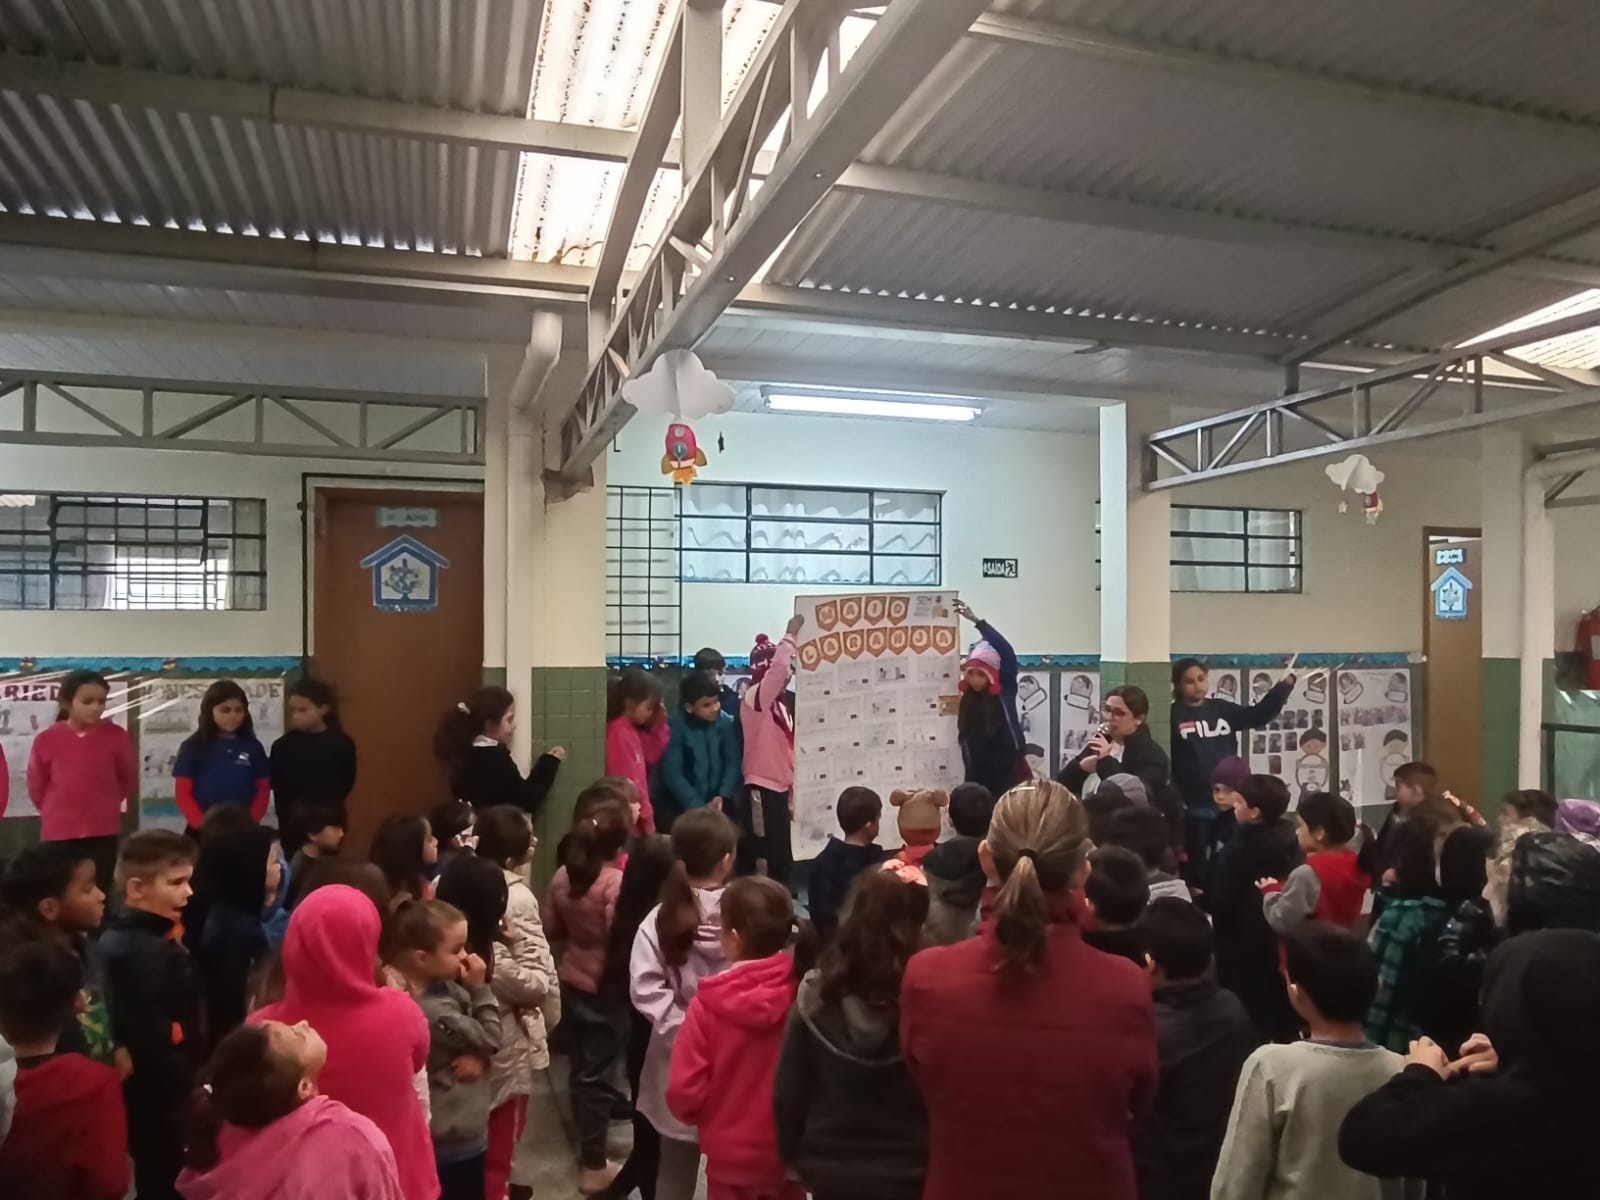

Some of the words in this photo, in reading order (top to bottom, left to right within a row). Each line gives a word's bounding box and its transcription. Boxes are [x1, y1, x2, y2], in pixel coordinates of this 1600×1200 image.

[818, 600, 905, 624] MAIO
[804, 628, 952, 664] LARANJA
[1179, 718, 1231, 739] FILA
